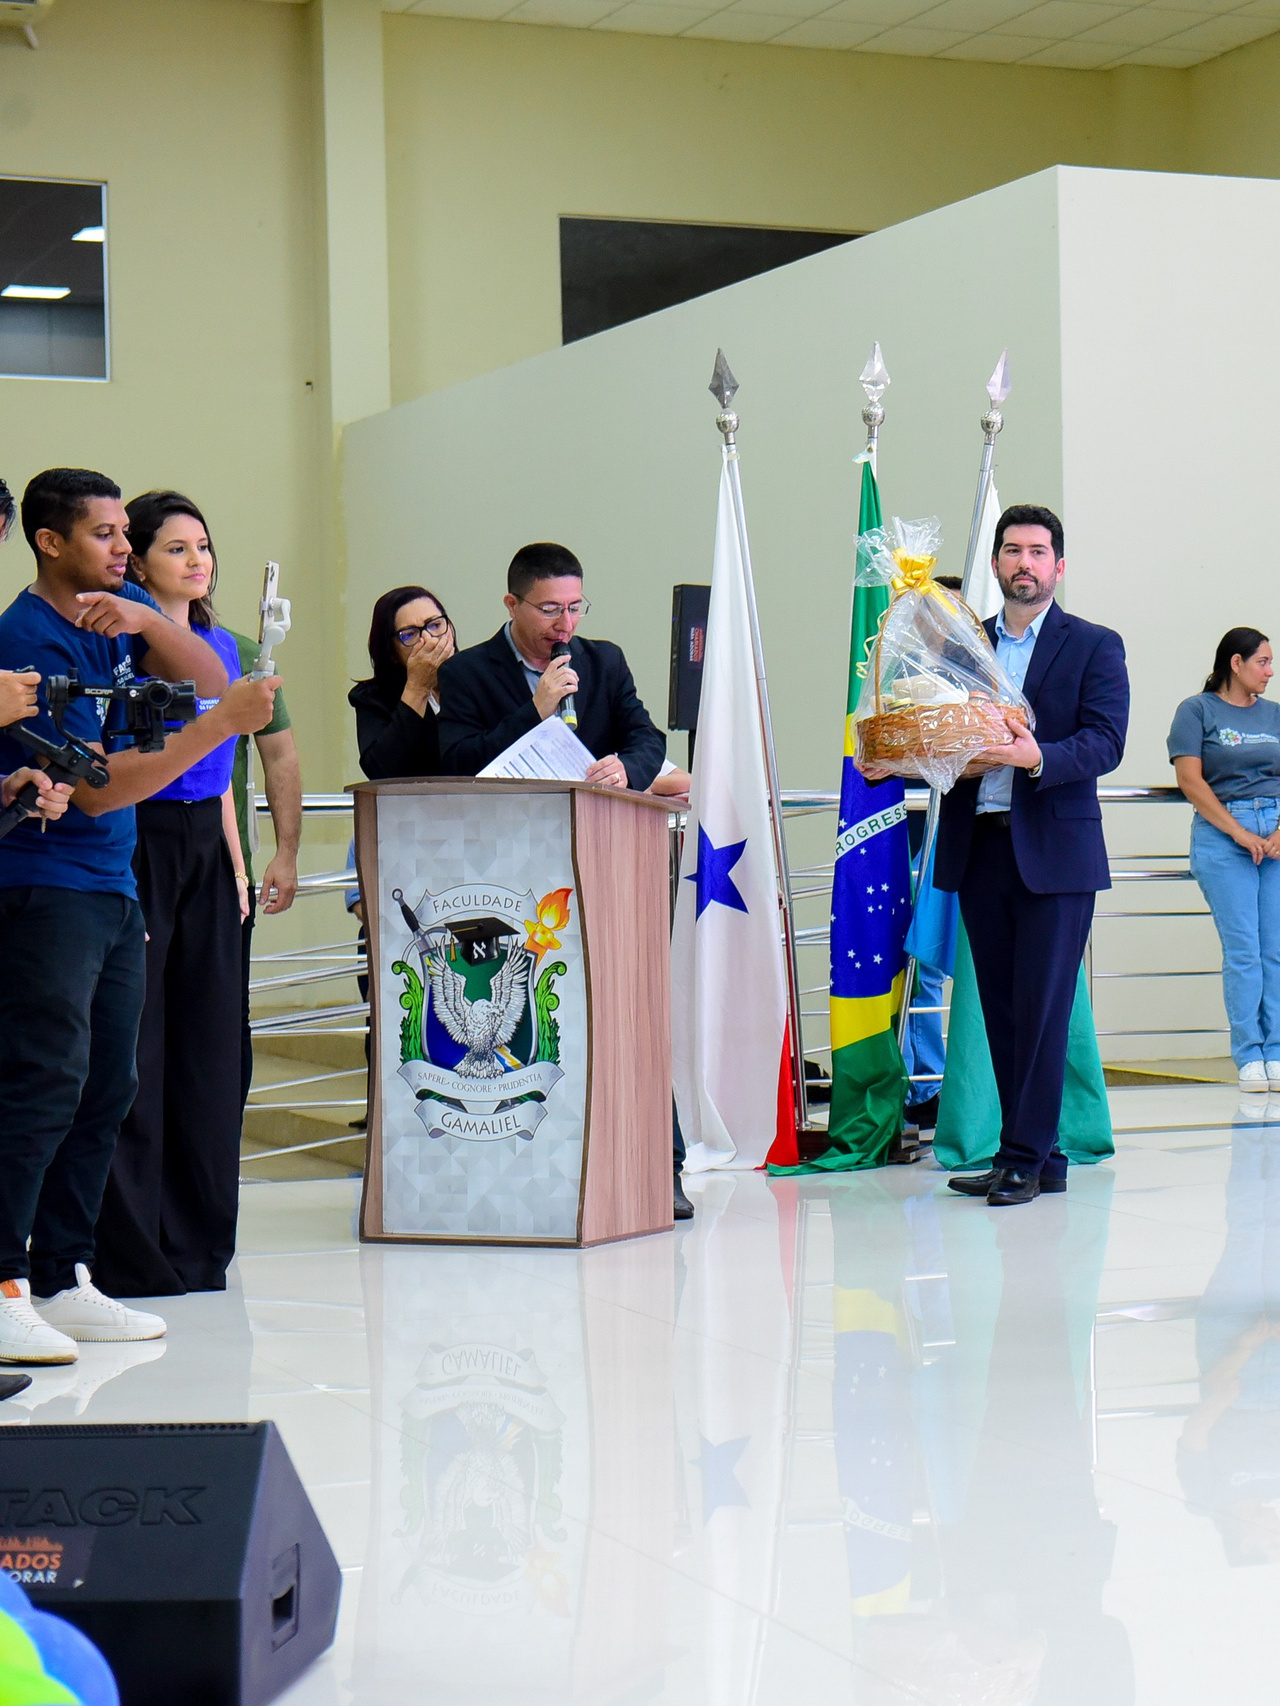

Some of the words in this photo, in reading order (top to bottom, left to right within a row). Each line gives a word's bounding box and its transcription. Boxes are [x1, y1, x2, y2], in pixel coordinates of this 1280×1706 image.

[432, 894, 522, 914] FACULDADE
[451, 1083, 492, 1093] COGNORE
[498, 1073, 543, 1092] PRUDENTIA
[441, 1112, 522, 1136] GAMALIEL
[0, 1552, 62, 1571] ADOS
